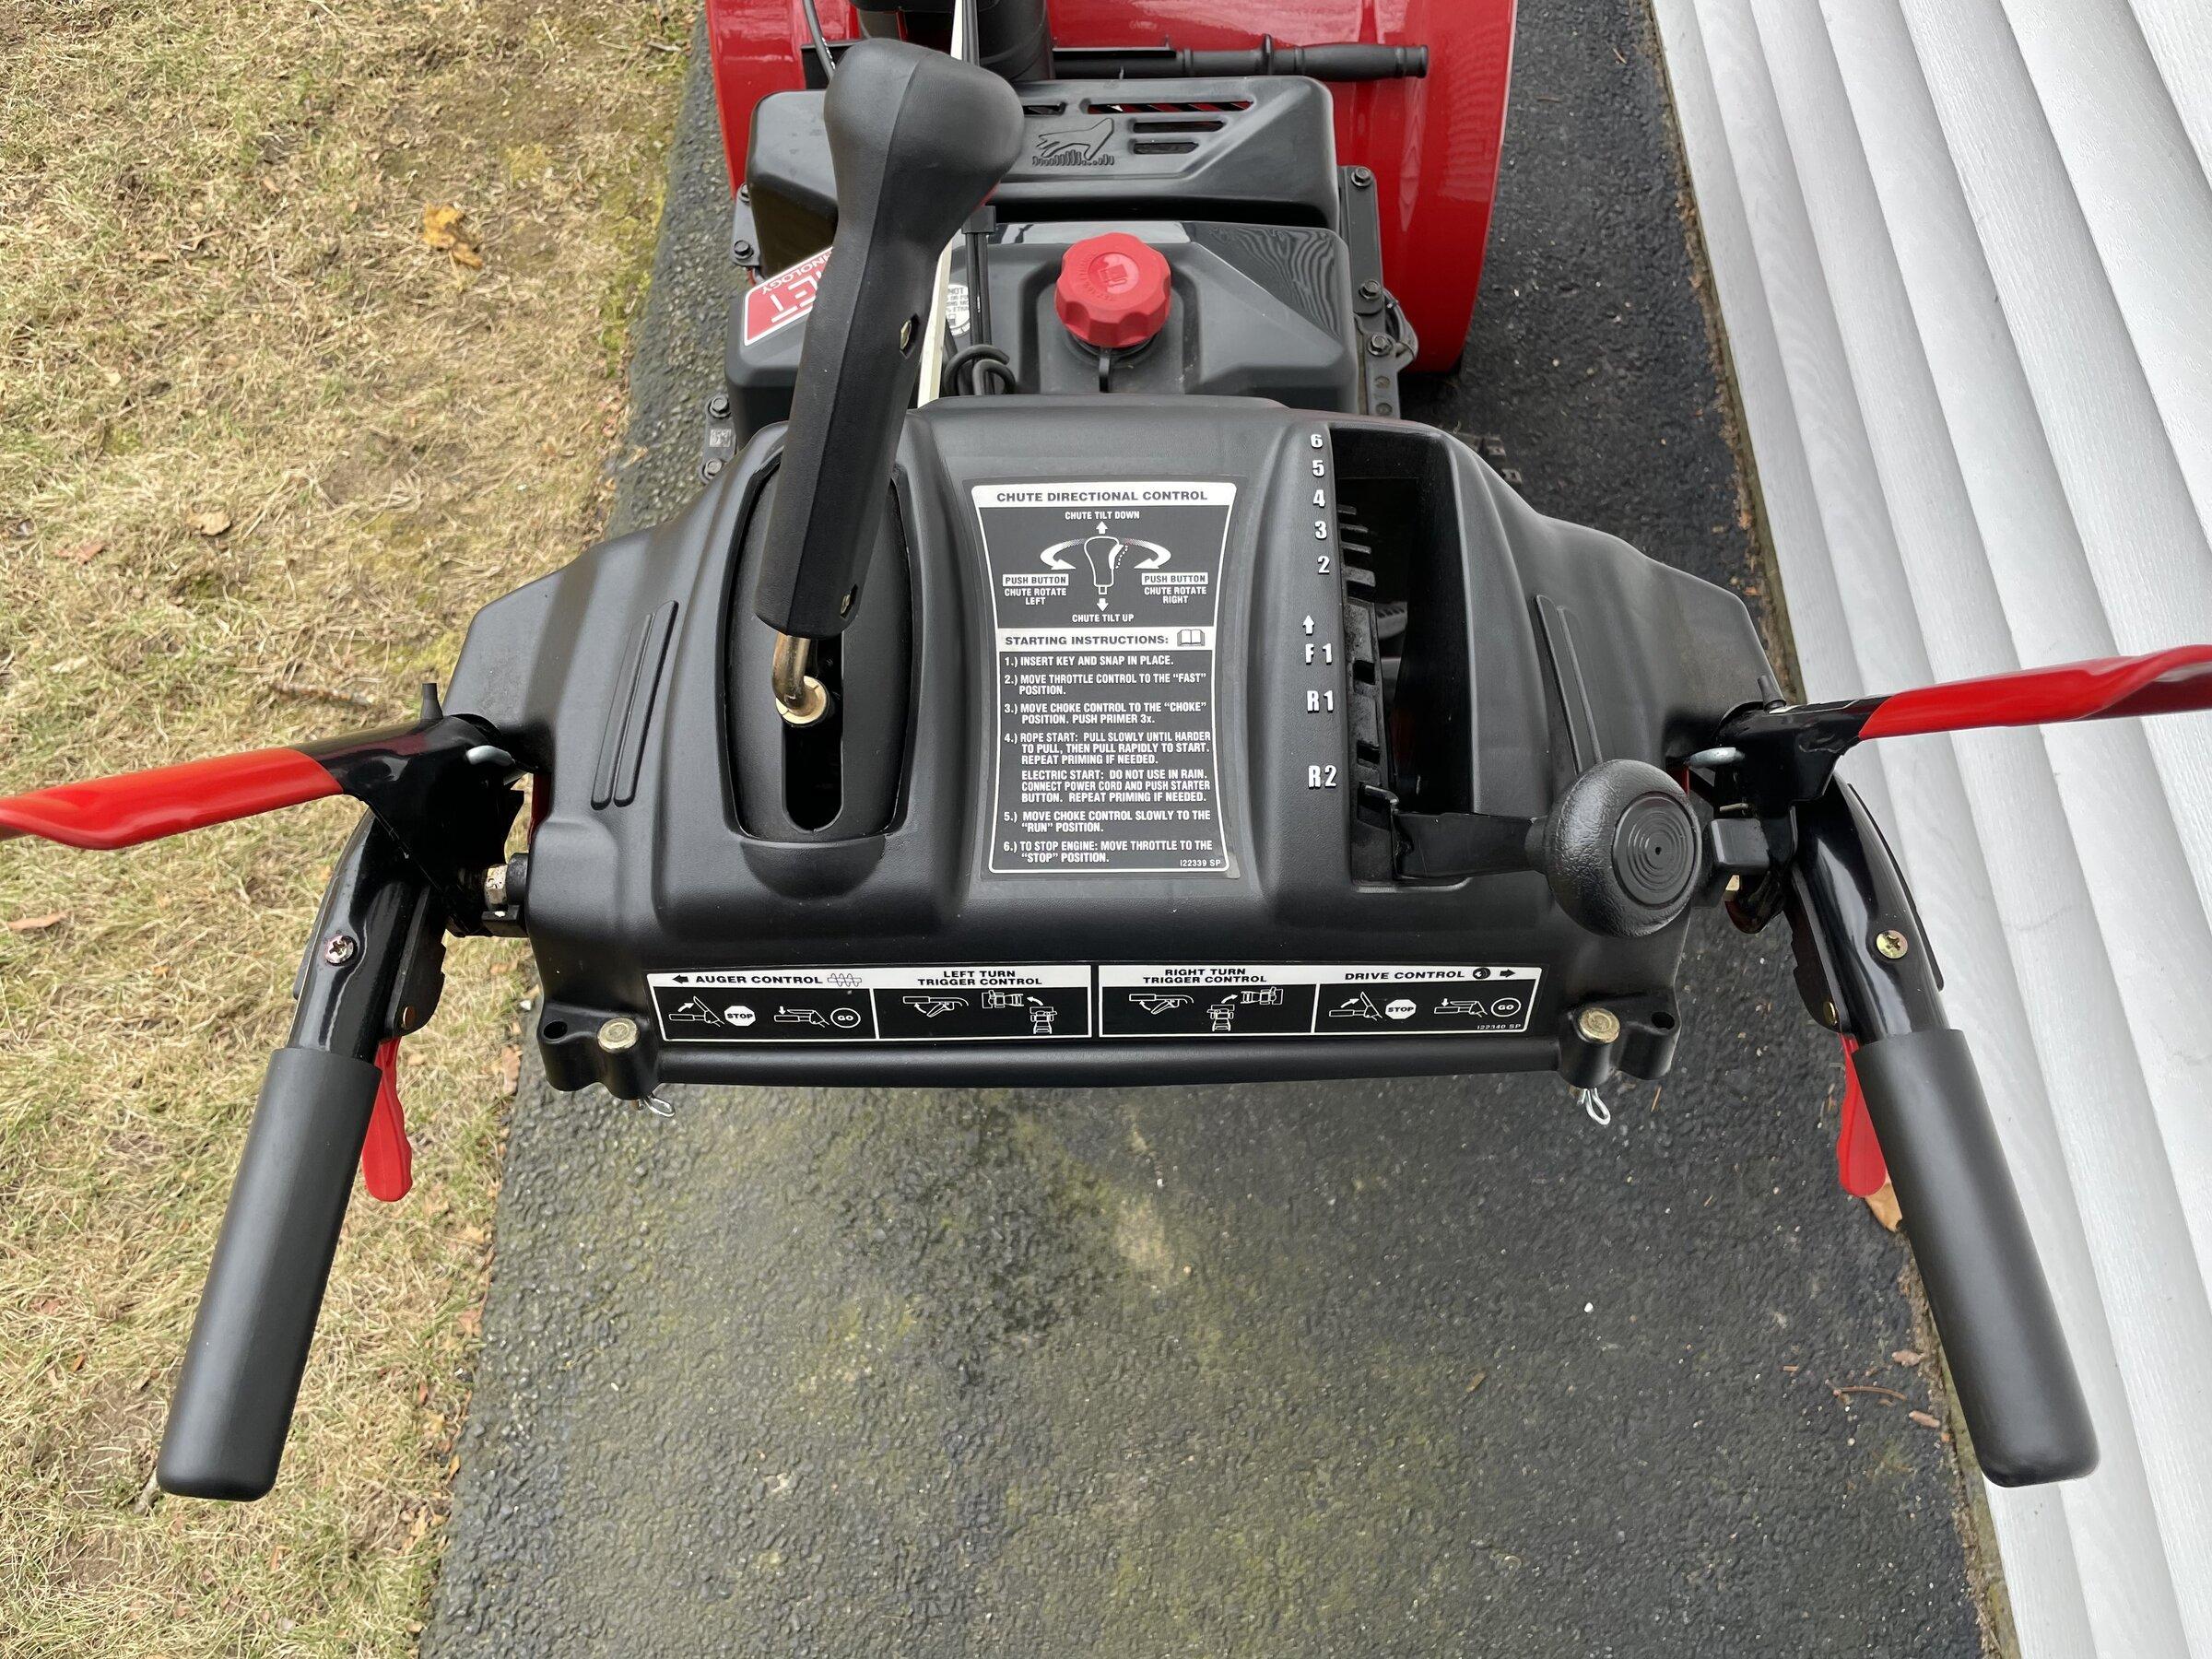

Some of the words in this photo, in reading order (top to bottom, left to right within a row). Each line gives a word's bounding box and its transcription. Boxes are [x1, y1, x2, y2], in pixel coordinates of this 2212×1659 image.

[1311, 434, 1323, 448] 6
[1312, 460, 1324, 477] 5
[996, 492, 1043, 502] CHUTE
[1047, 491, 1138, 501] DIRECTIONAL
[1142, 491, 1207, 500] CONTROL
[1313, 489, 1325, 507] 4
[1065, 512, 1092, 520] CHUTE
[1314, 521, 1327, 538] 3
[1318, 556, 1329, 573] 2
[1005, 576, 1029, 584] PUSH
[1031, 575, 1066, 584] BUTTON
[1144, 575, 1168, 583] PUSH
[1004, 588, 1031, 596] CHUTE
[1033, 588, 1066, 596] ROTATE
[1144, 587, 1171, 595] CHUTE
[1173, 587, 1206, 595] ROTATE
[1025, 597, 1045, 606] LEFT
[1163, 595, 1188, 604] RIGHT
[1072, 614, 1100, 622] CHUTE
[1101, 614, 1120, 622] TILT
[1123, 614, 1134, 622] UP
[1006, 637, 1066, 645] STARTING
[1071, 635, 1169, 644] INSTRUCTIONS:
[1005, 657, 1018, 667] 1.)
[1020, 656, 1054, 666] INSERT
[1056, 656, 1076, 665] KEY
[1077, 656, 1097, 665] AND
[1100, 656, 1124, 665] SNAP
[1127, 655, 1137, 665] IN
[1140, 655, 1174, 665] PLACE.
[1005, 675, 1018, 686] 2.)
[1020, 675, 1046, 684] MOVE
[1049, 674, 1094, 684] THROTTLE
[1096, 674, 1136, 683] CONTROL
[1139, 674, 1151, 683] TO
[1153, 674, 1171, 683] THE
[1019, 686, 1066, 695] POSITION.
[1005, 704, 1018, 714] 3.)
[1020, 703, 1048, 713] MOVE
[1050, 703, 1081, 712] CHOKE
[1084, 703, 1126, 712] CONTROL
[1129, 703, 1142, 712] TO
[1144, 702, 1161, 712] THE
[1022, 714, 1068, 724] POSITION.
[1073, 714, 1098, 724] PUSH
[1100, 714, 1138, 724] PRIMER
[1140, 714, 1155, 724] 3x.
[1005, 733, 1018, 745] 4.)
[1020, 733, 1044, 742] ROPE
[1046, 733, 1078, 742] START:
[1084, 733, 1107, 742] PULL
[1108, 732, 1145, 742] SLOWLY
[1147, 732, 1173, 741] UNTIL
[1175, 732, 1211, 741] HARDER
[1022, 744, 1034, 753] TO
[1037, 744, 1063, 755] PULL,
[1066, 744, 1090, 753] THEN
[1093, 744, 1116, 753] PULL
[1118, 743, 1159, 753] RAPIDLY
[1160, 743, 1173, 752] TO
[1175, 743, 1209, 752] START.
[1021, 755, 1060, 765] REPEAT
[1062, 755, 1103, 764] PRIMING
[1106, 755, 1115, 764] IF
[1117, 755, 1158, 764] NEEDED.
[1021, 771, 1067, 781] ELECTRIC
[1069, 771, 1104, 780] START:
[1109, 770, 1122, 780] DO
[1124, 770, 1145, 779] NOT
[1147, 770, 1166, 779] USE
[1169, 770, 1178, 779] IN
[1181, 769, 1206, 779] RAIN.
[1021, 782, 1062, 792] CONNECT
[1064, 782, 1096, 791] POWER
[1099, 782, 1122, 791] CORD
[1124, 782, 1143, 791] AND
[1146, 781, 1169, 790] PUSH
[1171, 781, 1210, 790] STARTER
[1021, 793, 1063, 803] BUTTON.
[1069, 793, 1107, 803] REPEAT
[1109, 793, 1151, 802] PRIMING
[1154, 793, 1163, 802] IF
[1165, 792, 1206, 802] NEEDED.
[1004, 812, 1018, 822] 5.)
[1023, 811, 1052, 821] MOVE
[1053, 811, 1087, 820] CHOKE
[1088, 811, 1133, 820] CONTROL
[1135, 810, 1173, 820] SLOWLY
[1176, 810, 1190, 820] TO
[1192, 810, 1210, 819] THE
[1056, 822, 1103, 832] POSITION.
[1004, 841, 1018, 853] 6.)
[1020, 841, 1032, 852] TO
[1034, 841, 1059, 851] STOP
[1061, 841, 1098, 851] ENGINE:
[1100, 841, 1128, 851] MOVE
[1130, 841, 1177, 851] THROTTLE
[1180, 841, 1193, 850] TO
[1194, 841, 1212, 850] THE
[1061, 853, 1109, 862] POSITION.
[1394, 971, 1465, 979] CONTROL
